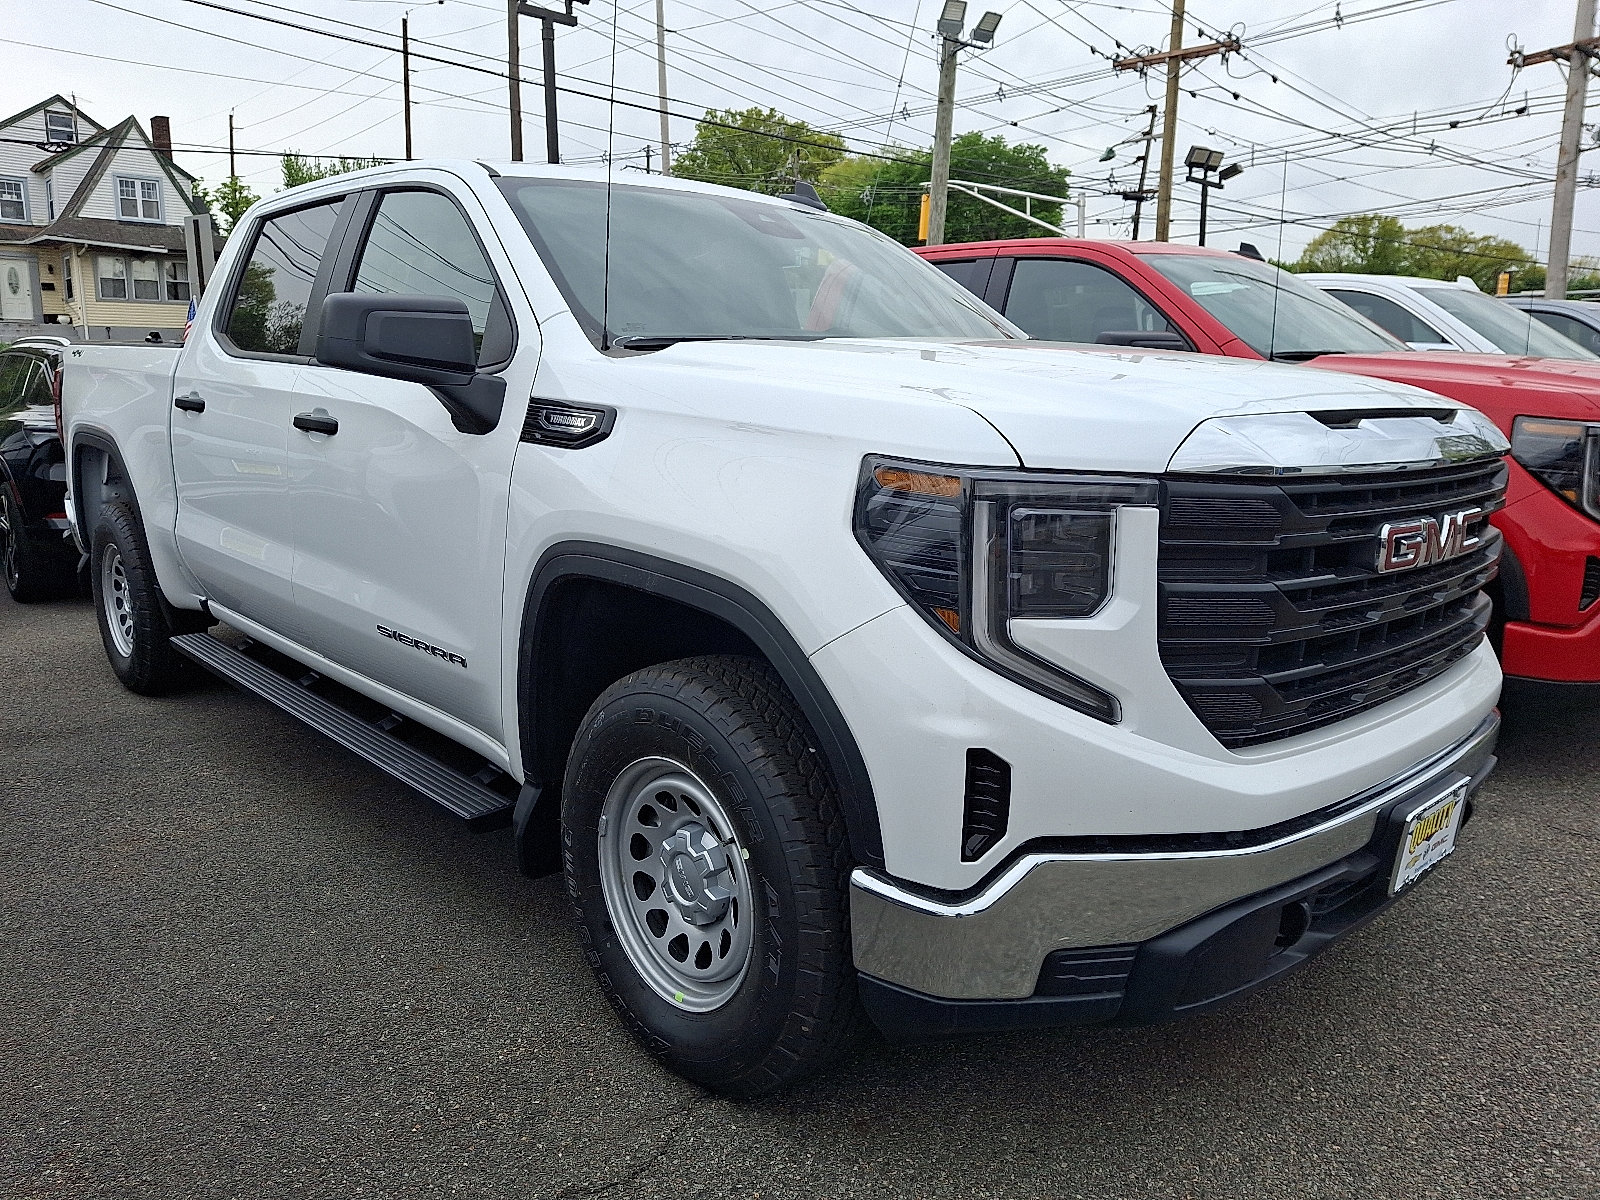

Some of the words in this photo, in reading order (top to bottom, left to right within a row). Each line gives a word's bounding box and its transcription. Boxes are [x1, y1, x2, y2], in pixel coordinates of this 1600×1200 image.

[550, 413, 587, 427] TURBOMAX
[1378, 507, 1482, 574] GMC
[376, 624, 468, 669] SIERRA
[1408, 800, 1456, 855] QUALITY
